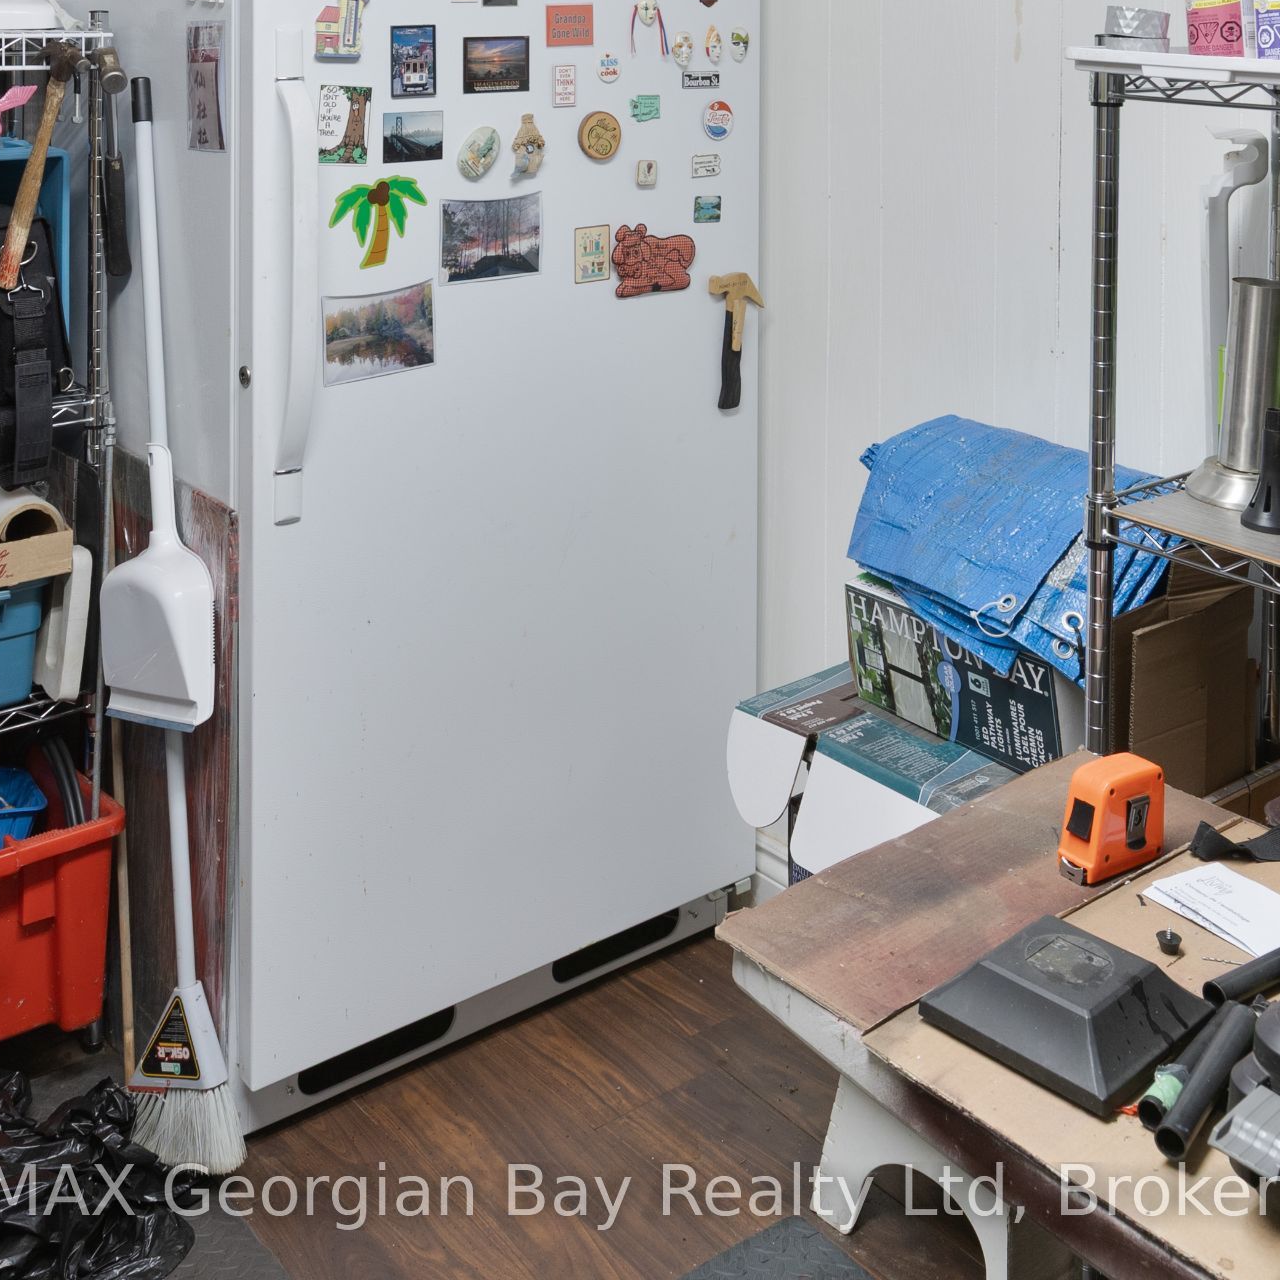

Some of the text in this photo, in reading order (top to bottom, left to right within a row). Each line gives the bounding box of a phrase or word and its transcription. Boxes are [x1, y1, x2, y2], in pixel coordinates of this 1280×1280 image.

[553, 13, 586, 24] Grandpa
[551, 27, 590, 39] Gone Wild
[600, 59, 618, 67] KISS
[600, 69, 618, 77] cook
[684, 75, 710, 87] Bourbon
[985, 701, 998, 749] PATHWAY
[1017, 702, 1026, 733] POUR
[982, 726, 990, 746] LED
[994, 717, 1006, 753] LIGHTS
[1009, 698, 1023, 761] LUMINAIRES
[1021, 735, 1030, 754] DEL
[1027, 726, 1039, 768] CHEMIN
